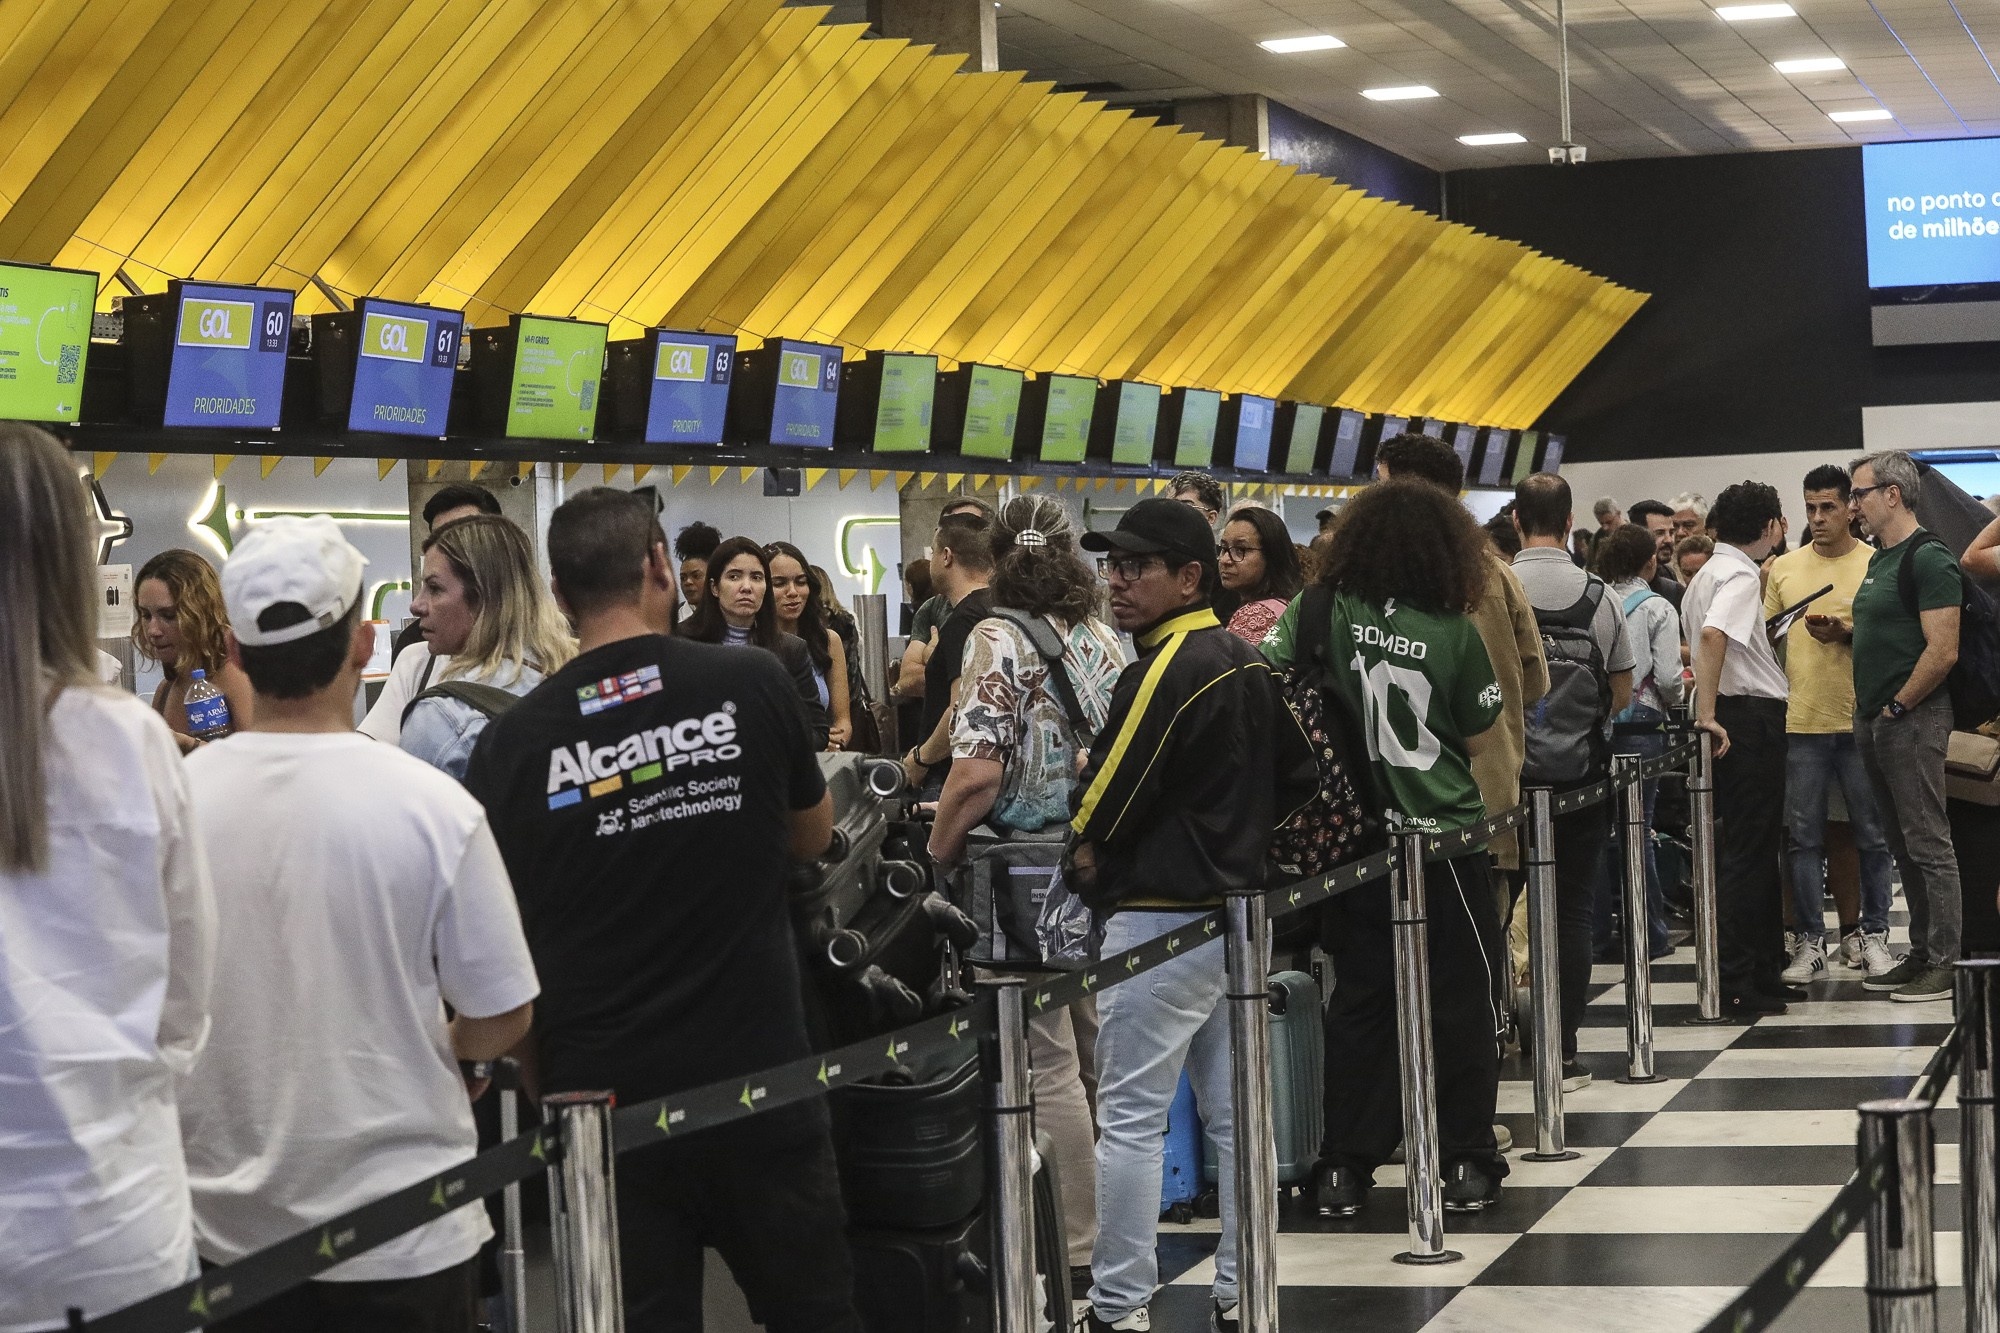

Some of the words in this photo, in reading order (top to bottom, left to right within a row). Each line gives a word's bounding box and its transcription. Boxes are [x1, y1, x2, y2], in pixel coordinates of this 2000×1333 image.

[1887, 196, 1916, 212] no
[1920, 191, 1986, 215] ponto
[1888, 219, 1917, 240] de
[1922, 216, 2000, 238] milhõe
[200, 308, 233, 339] GOL
[266, 311, 284, 336] 60
[380, 323, 408, 353] GOL
[437, 329, 453, 353] 61
[670, 350, 693, 374] GOL
[716, 352, 729, 372] 63
[790, 358, 808, 382] GOL
[826, 361, 837, 381] 64
[193, 397, 256, 415] PRIORIDADES
[373, 404, 427, 424] PRIORIDADES
[672, 420, 701, 433] PRIORITY
[1351, 623, 1427, 660] BOMBO
[1350, 650, 1441, 771] 10
[547, 711, 737, 794] Alcance
[666, 744, 742, 772] PRO
[687, 775, 741, 796] Society
